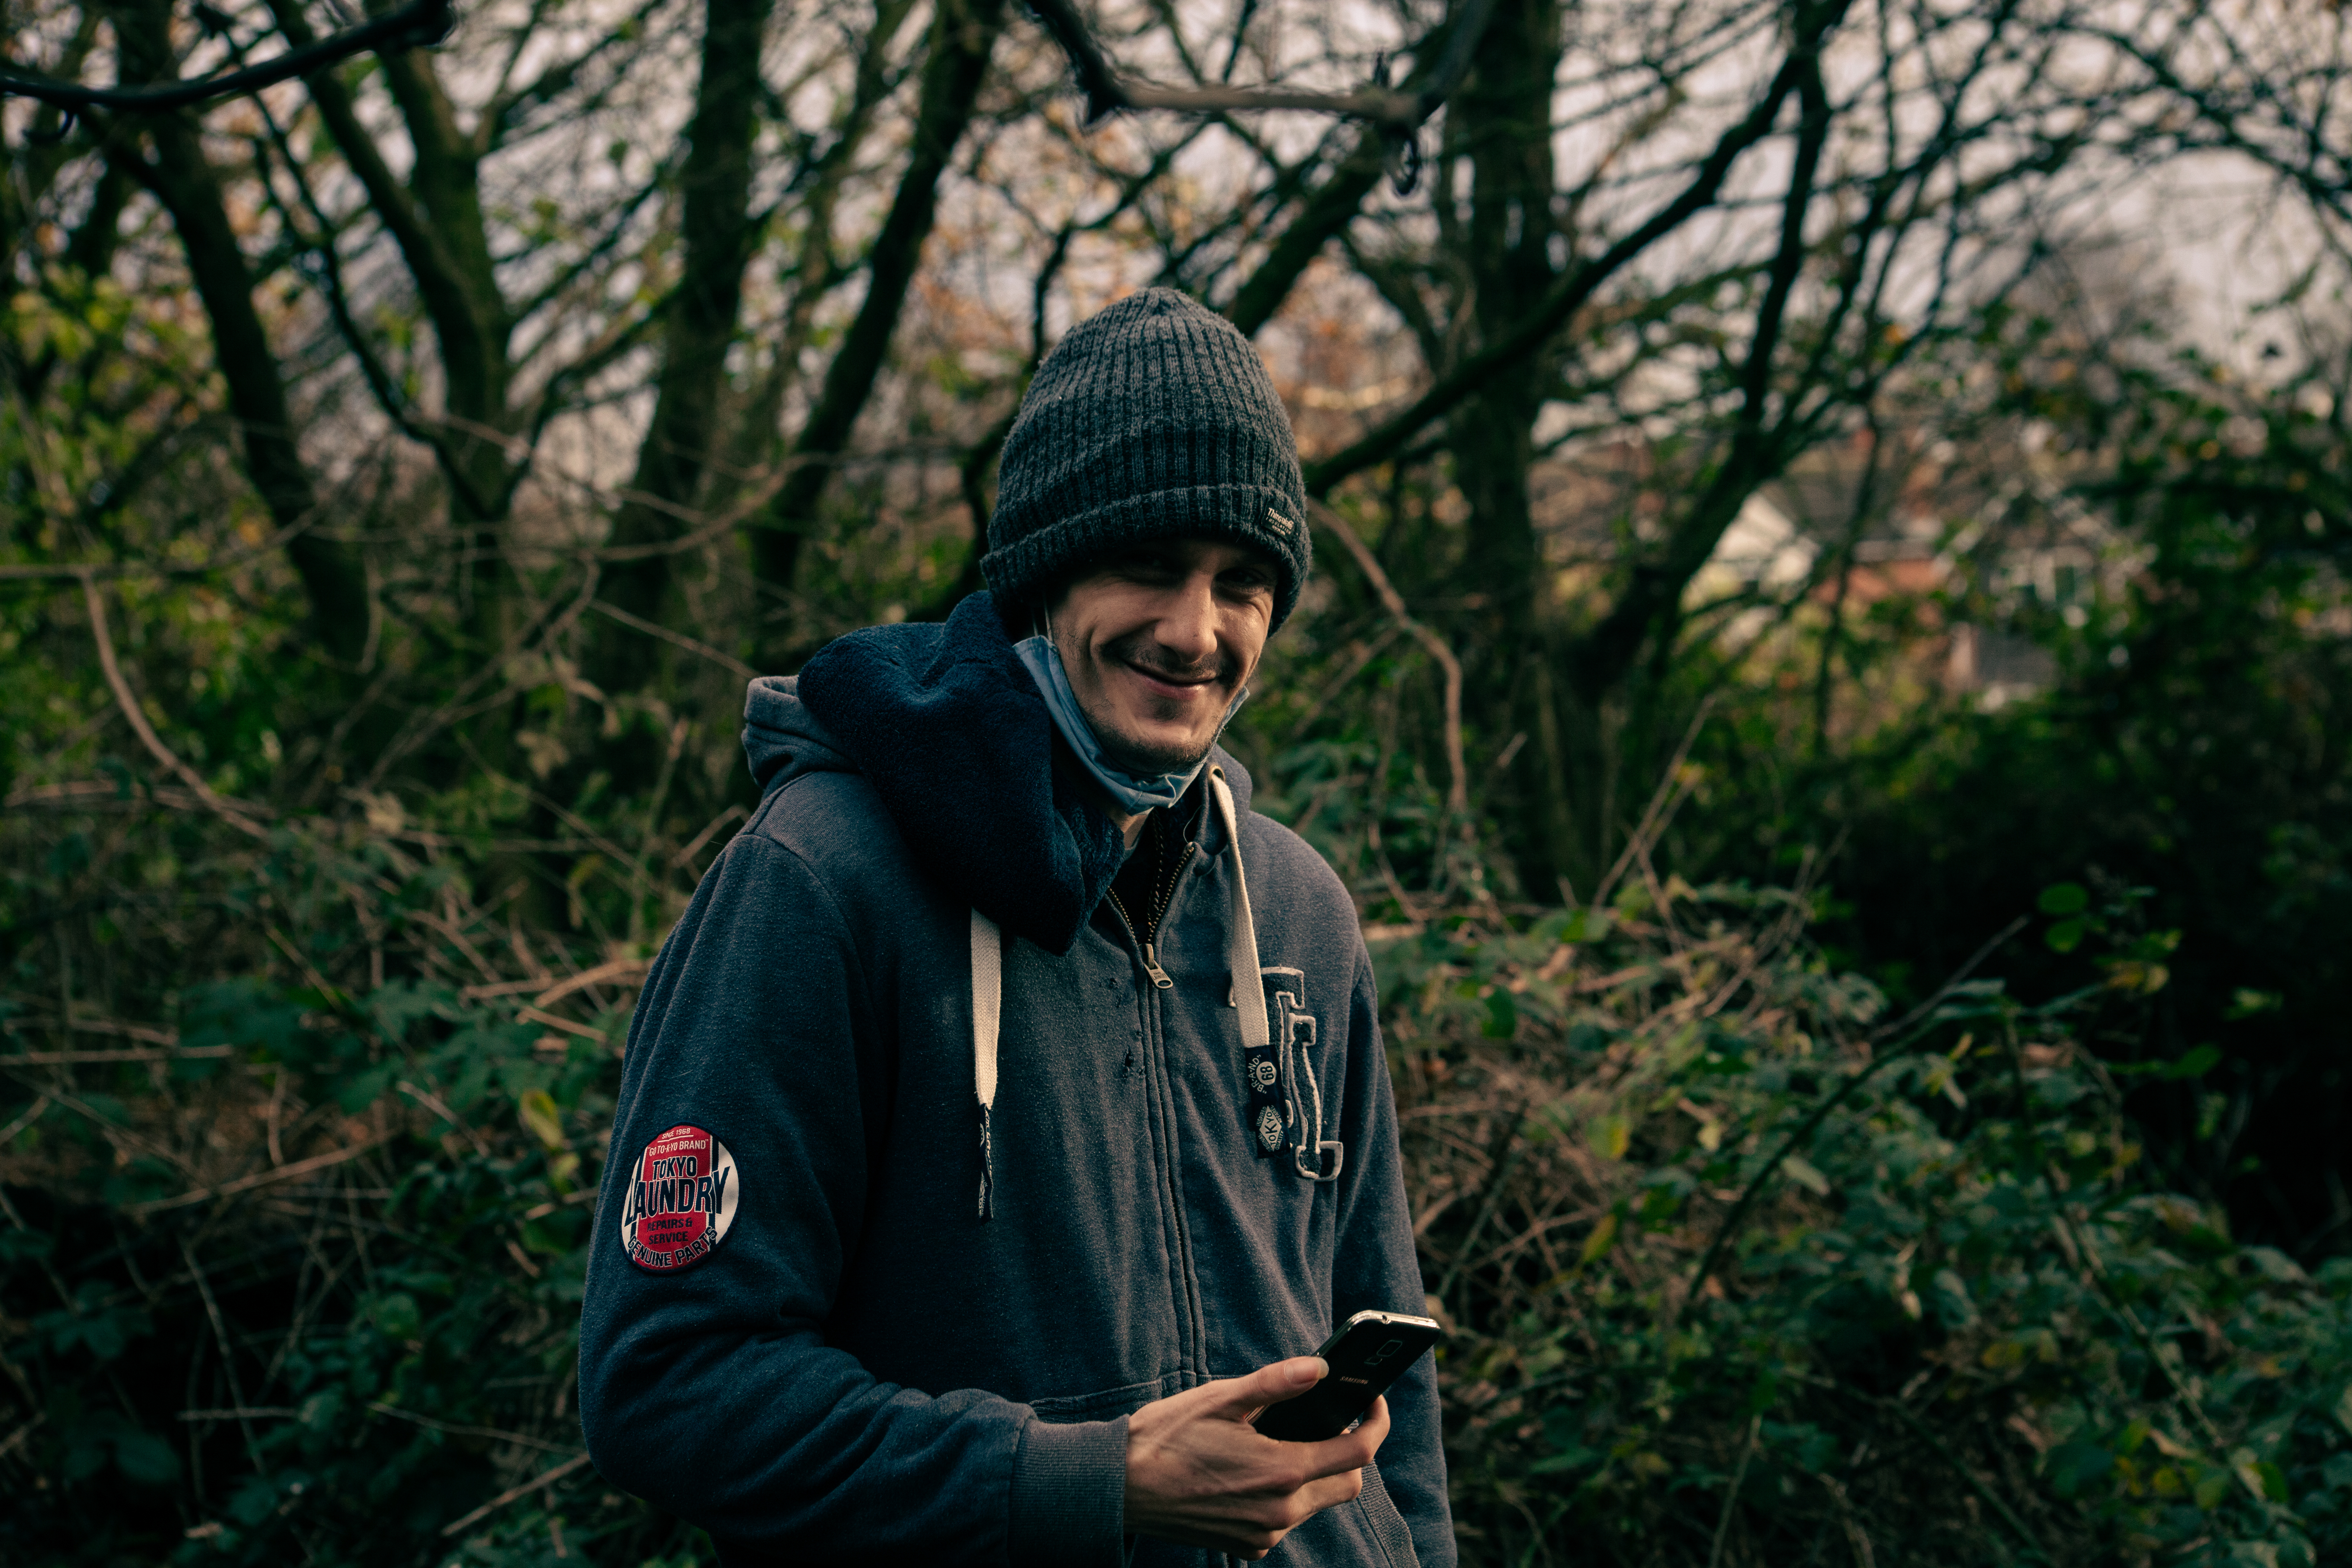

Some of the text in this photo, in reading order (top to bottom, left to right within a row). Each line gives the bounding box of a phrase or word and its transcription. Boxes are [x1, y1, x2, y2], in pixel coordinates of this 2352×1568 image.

[1266, 517, 1292, 535] INSULATION
[1260, 1065, 1274, 1081] 68
[1256, 1106, 1267, 1127] INSPIRED
[1270, 1105, 1282, 1123] APPAREL
[662, 1130, 675, 1139] SINCE
[1264, 1112, 1277, 1145] TOKYO
[1258, 1133, 1271, 1153] ORIGINAL
[1275, 1130, 1284, 1150] QUALITY
[652, 1155, 698, 1181] TOKYO
[624, 1166, 731, 1228] LAUNDRY
[647, 1217, 693, 1232] REPAIRS &
[628, 1225, 718, 1268] GENUINE PARTS
[648, 1231, 689, 1245] SERVICE
[1339, 1375, 1369, 1385] SAMSUNG
